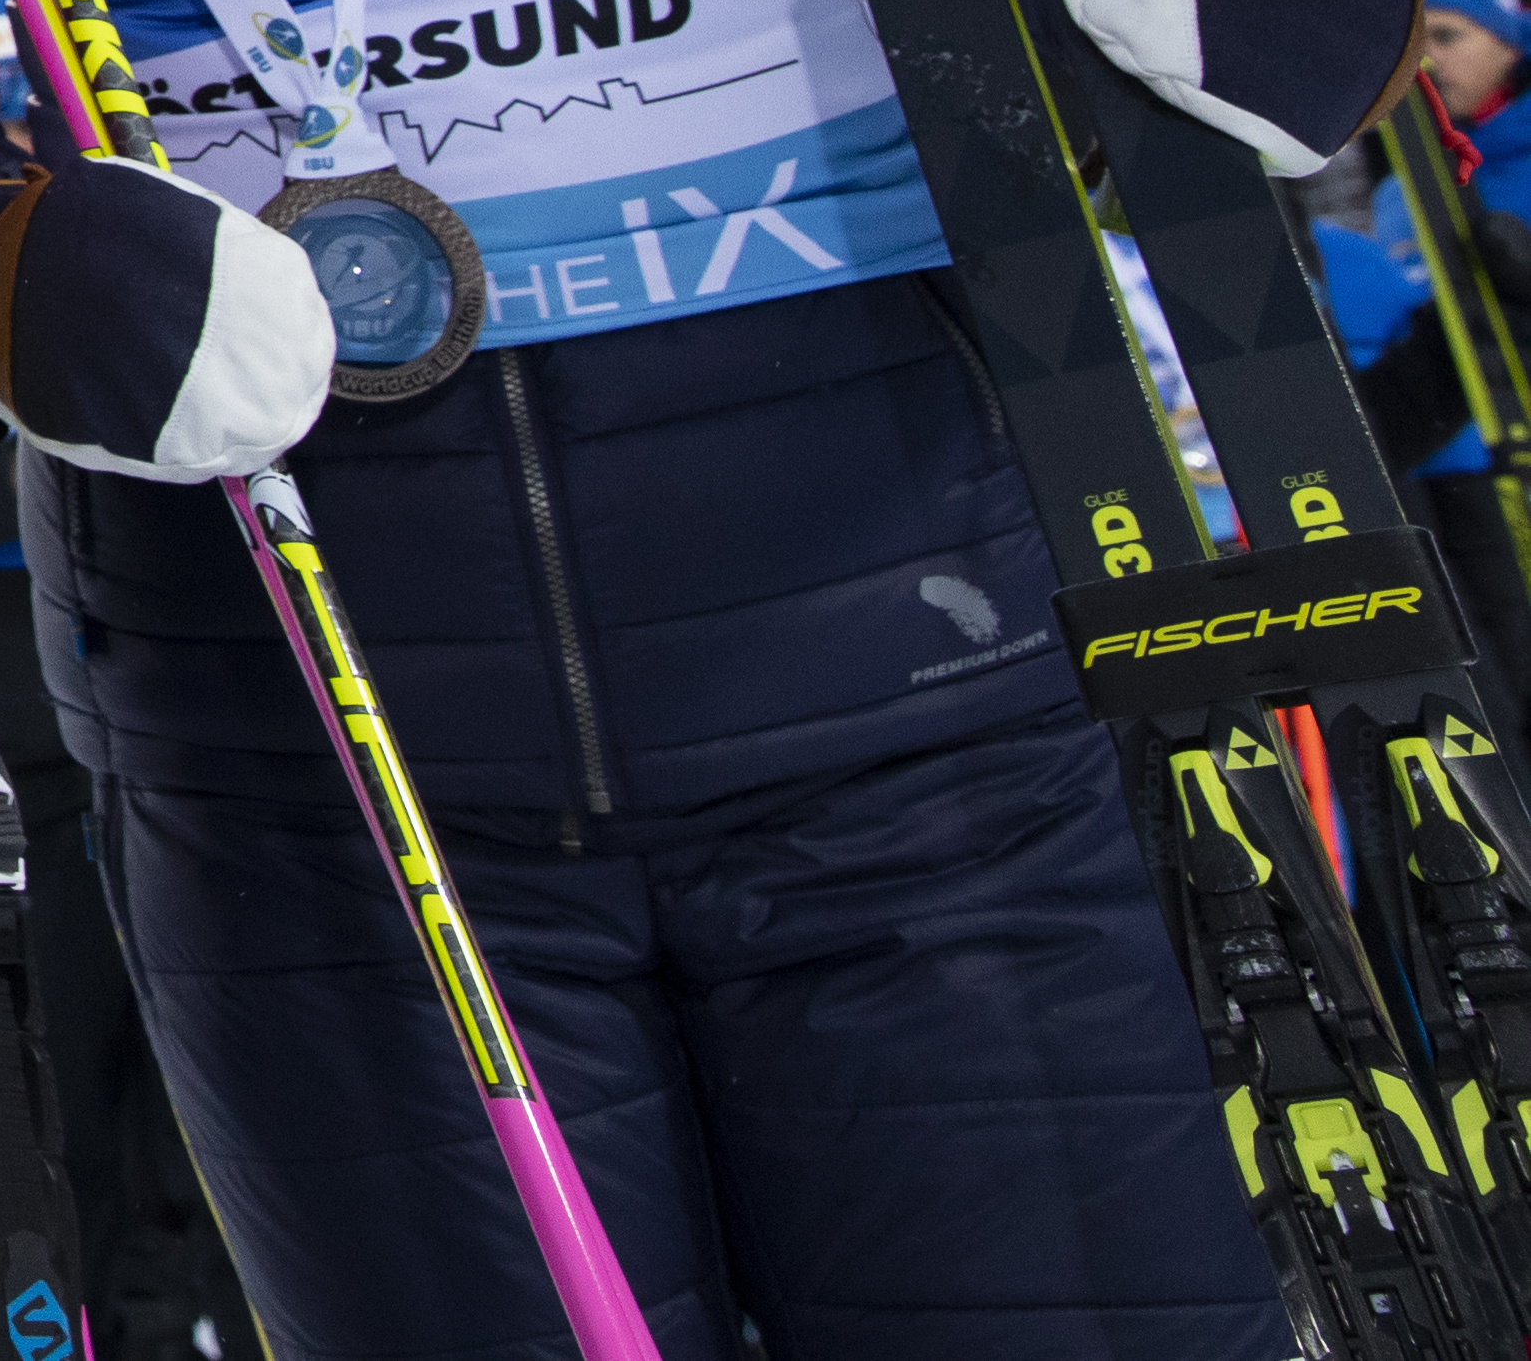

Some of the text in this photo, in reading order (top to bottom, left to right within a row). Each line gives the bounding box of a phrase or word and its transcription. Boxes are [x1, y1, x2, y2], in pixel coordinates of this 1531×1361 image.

[486, 253, 618, 322] HE
[911, 630, 1049, 683] PREMIUM DOWN
[1082, 586, 1423, 669] FISCHER
